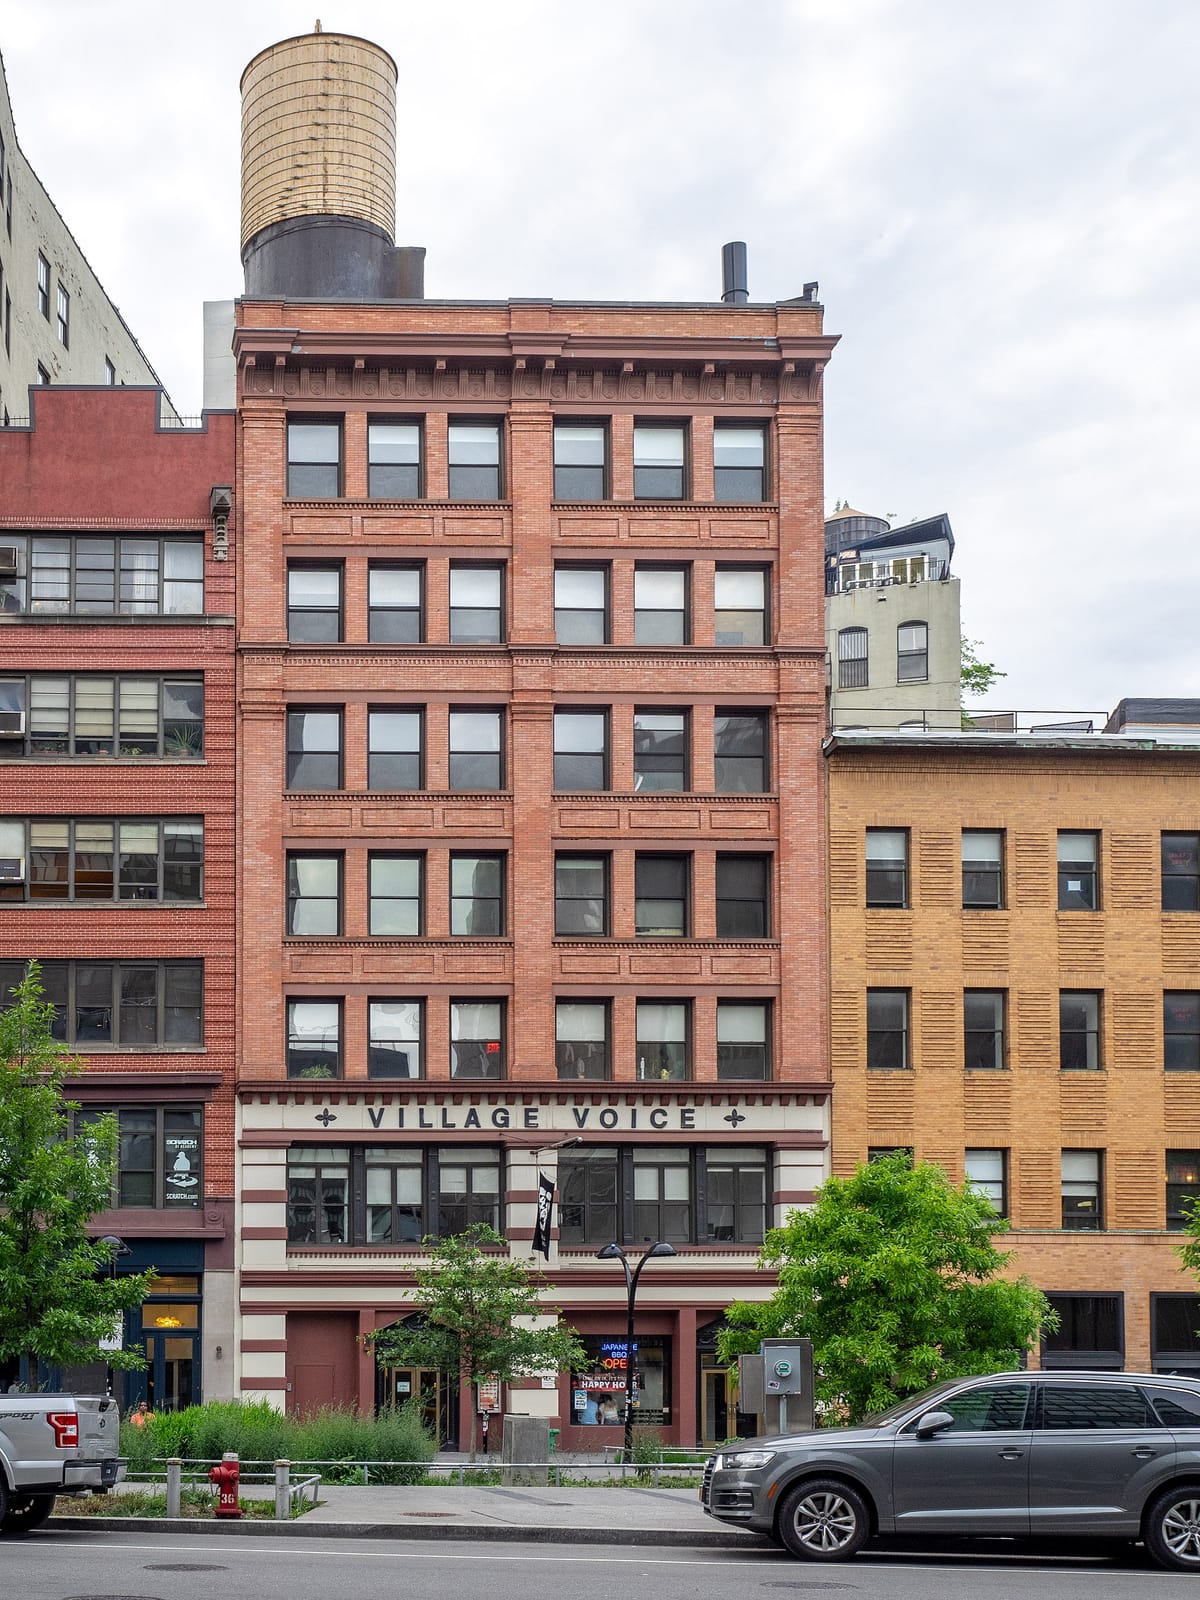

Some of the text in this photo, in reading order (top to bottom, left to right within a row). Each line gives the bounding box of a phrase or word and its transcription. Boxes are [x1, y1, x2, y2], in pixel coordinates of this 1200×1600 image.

[368, 1107, 696, 1129] VILLAGE VOICE
[601, 1343, 638, 1351] JAPANEE
[611, 1351, 628, 1359] BBQ
[605, 1358, 628, 1369] OPE
[581, 1380, 638, 1389] HAPPY HOR
[221, 1493, 235, 1504] 36
